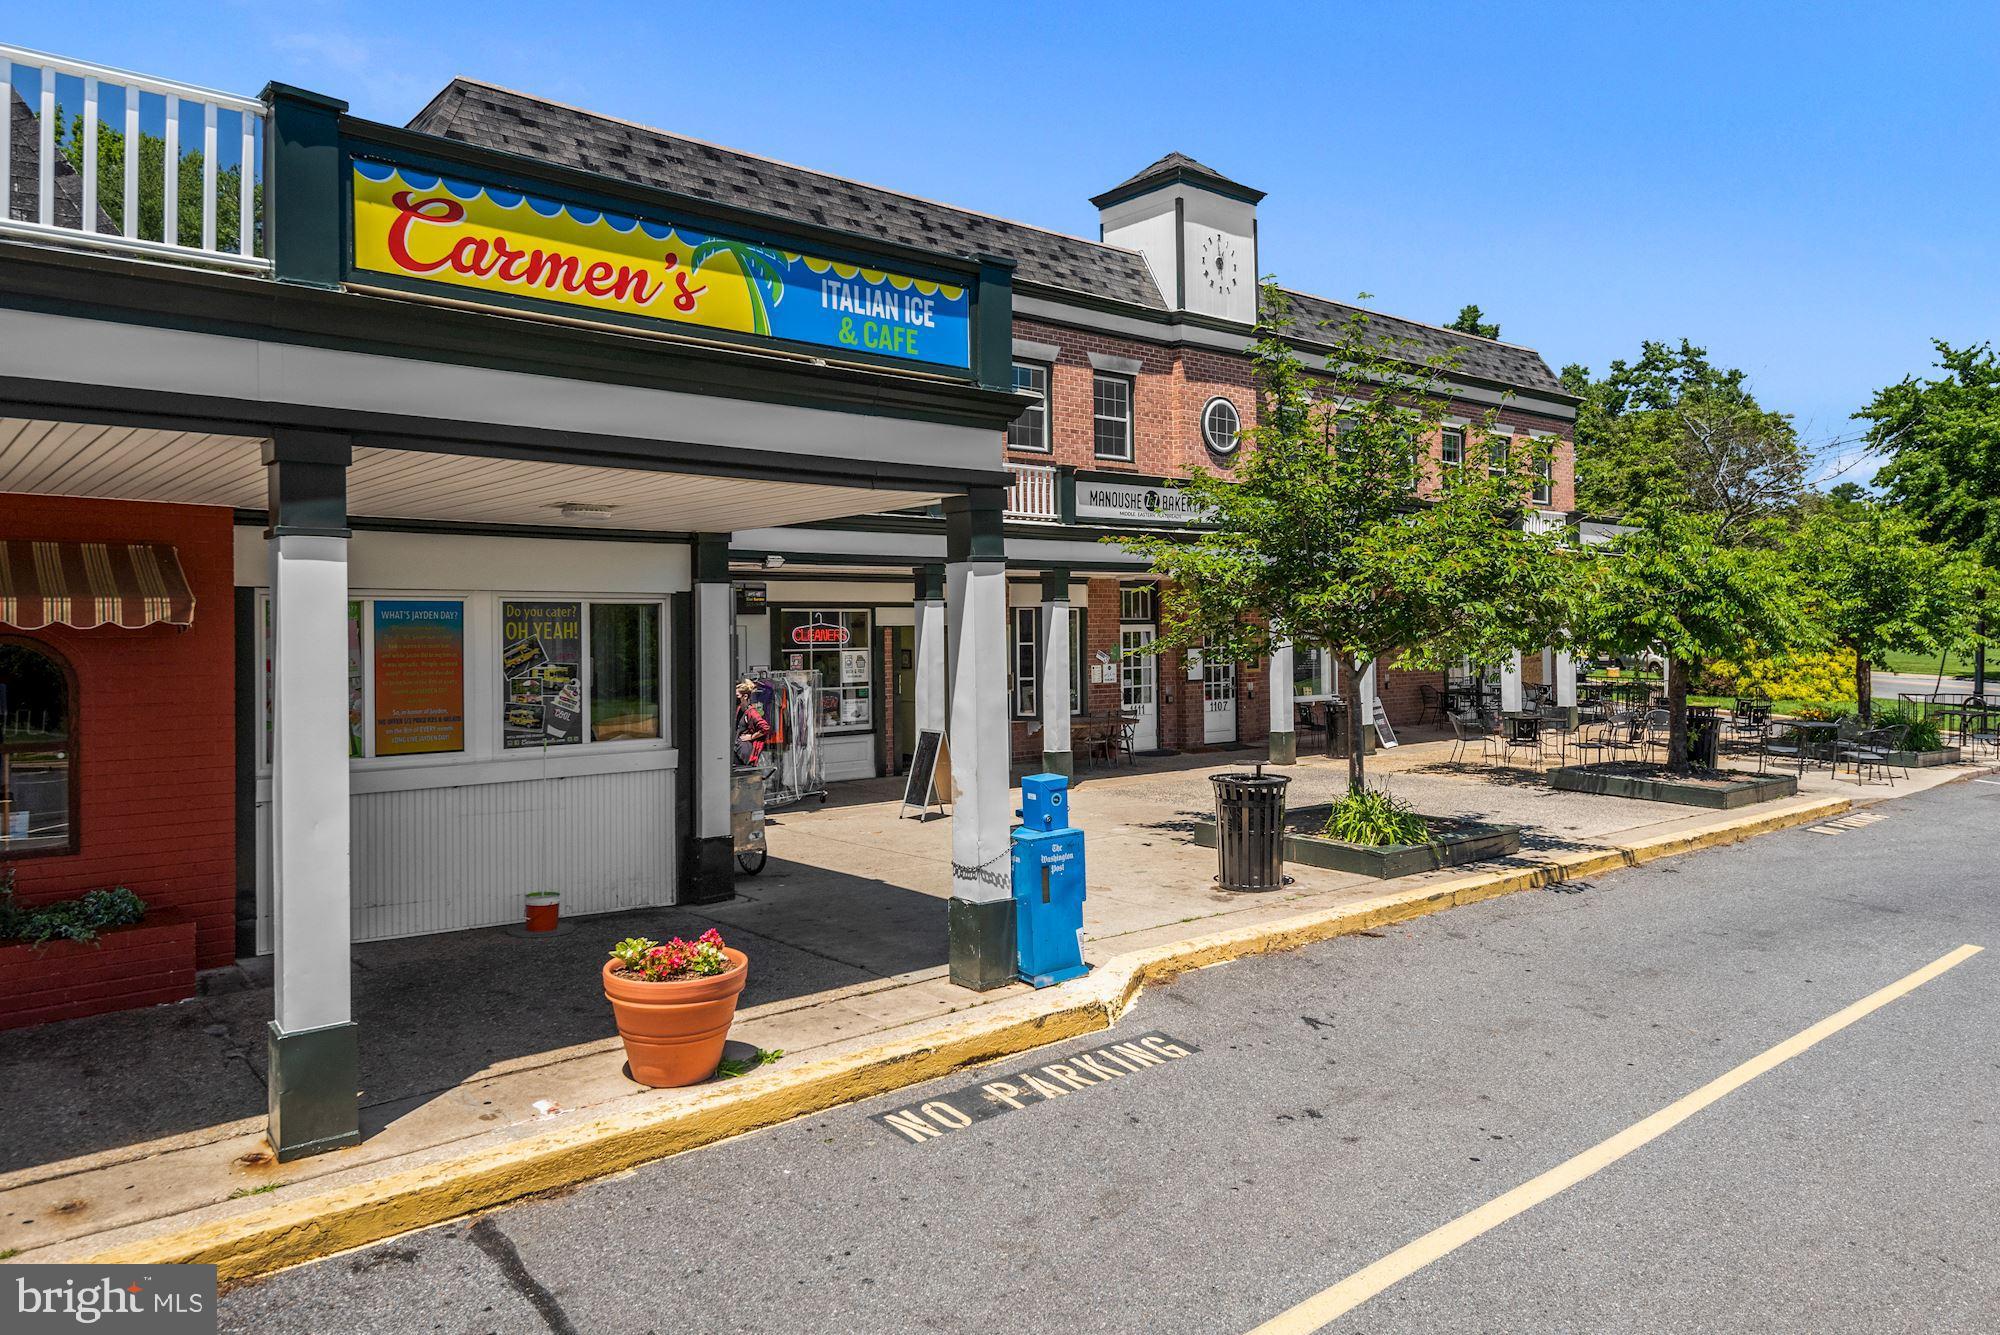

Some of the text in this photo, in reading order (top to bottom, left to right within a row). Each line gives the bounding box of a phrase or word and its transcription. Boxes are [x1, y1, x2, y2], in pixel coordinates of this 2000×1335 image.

[387, 191, 707, 313] Carmen's
[821, 279, 935, 328] ITALIAN ICE
[838, 316, 919, 355] & CAFE
[1089, 490, 1142, 509] MANOUSHE
[381, 610, 458, 621] WHAT'S JAYDEN DAY?
[506, 604, 577, 620] Do you cater?
[505, 621, 578, 640] OH YEAH!
[795, 628, 847, 642] CLEANERS
[1210, 701, 1228, 712] 1107
[1051, 844, 1063, 853] The
[1040, 853, 1074, 864] Washington
[1051, 863, 1065, 875] Post
[884, 1036, 1193, 1143] NO PARKING
